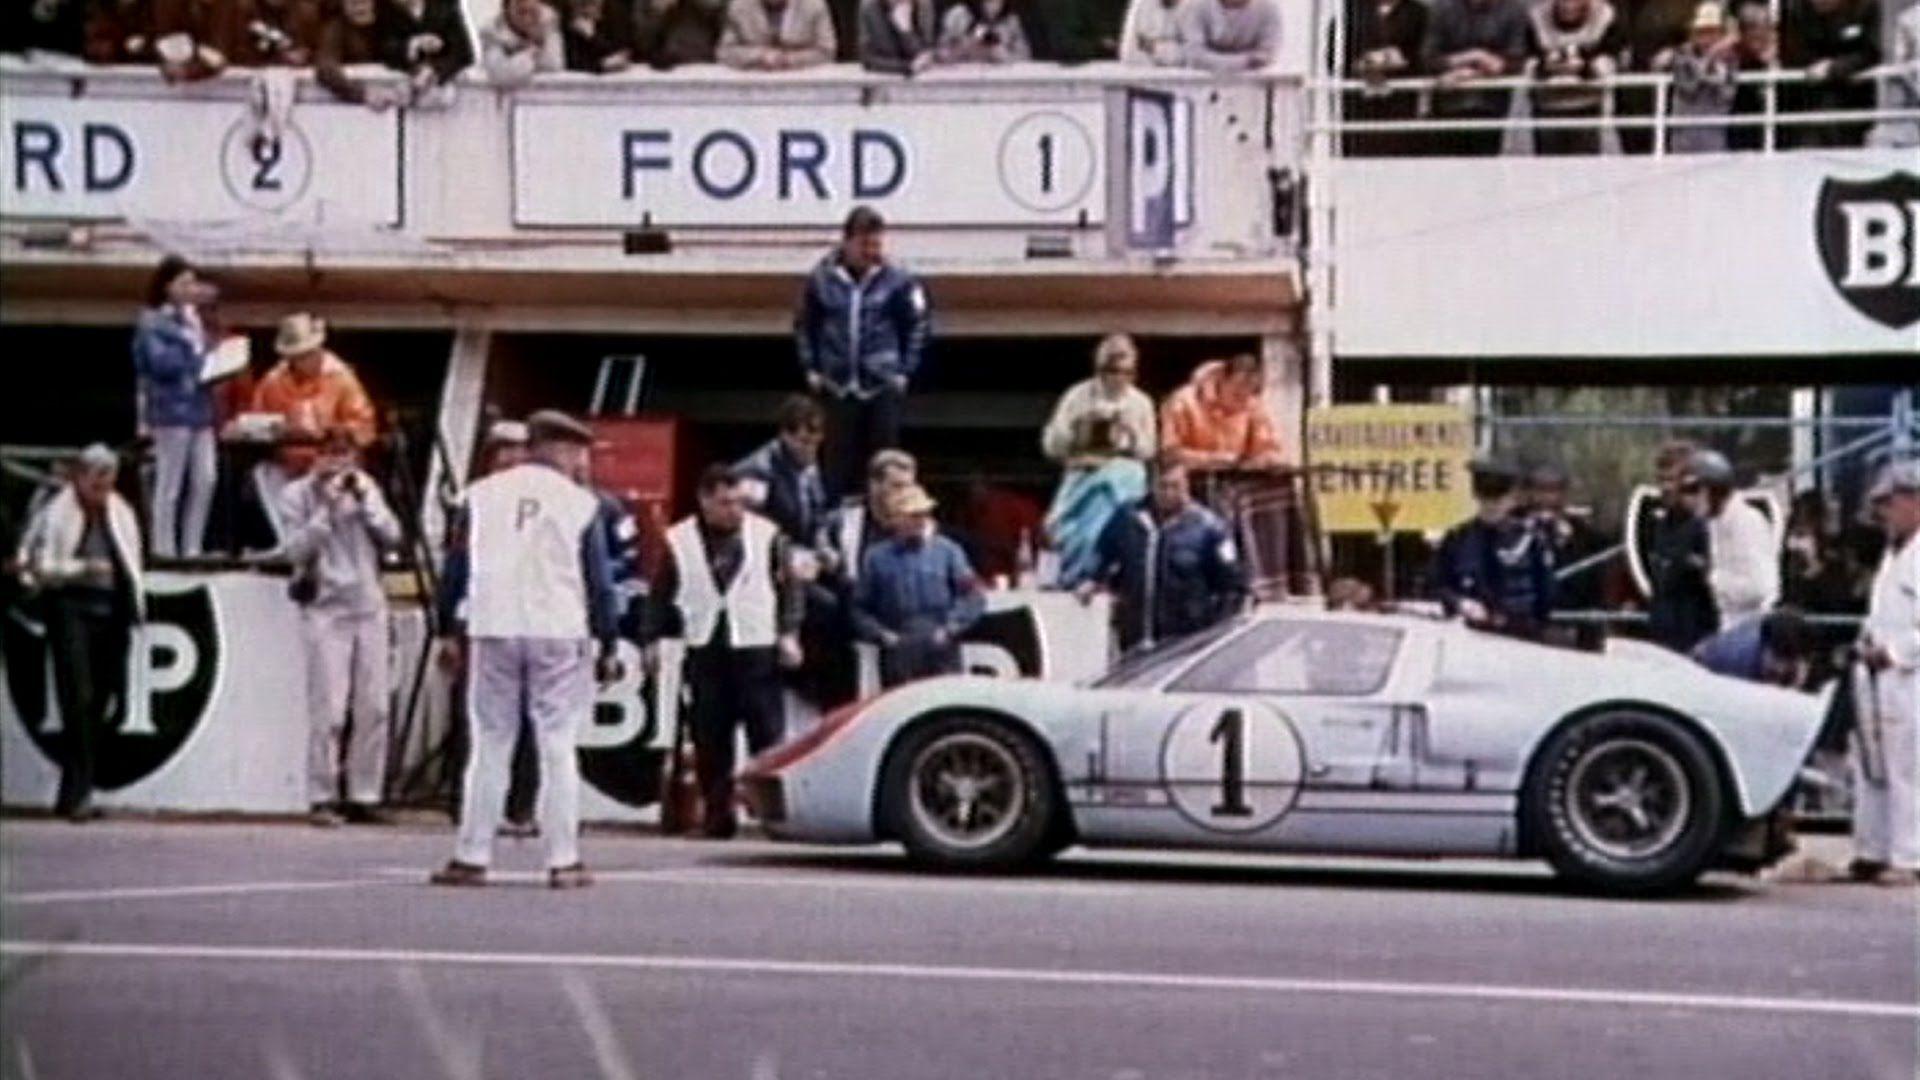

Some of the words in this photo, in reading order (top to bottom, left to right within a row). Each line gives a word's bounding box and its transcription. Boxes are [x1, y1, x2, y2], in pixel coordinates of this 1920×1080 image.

[250, 132, 282, 189] 2
[622, 128, 907, 201] FORD
[1038, 133, 1053, 194] 1
[1838, 202, 1920, 286] B
[515, 497, 542, 531] P
[1210, 705, 1254, 817] 1
